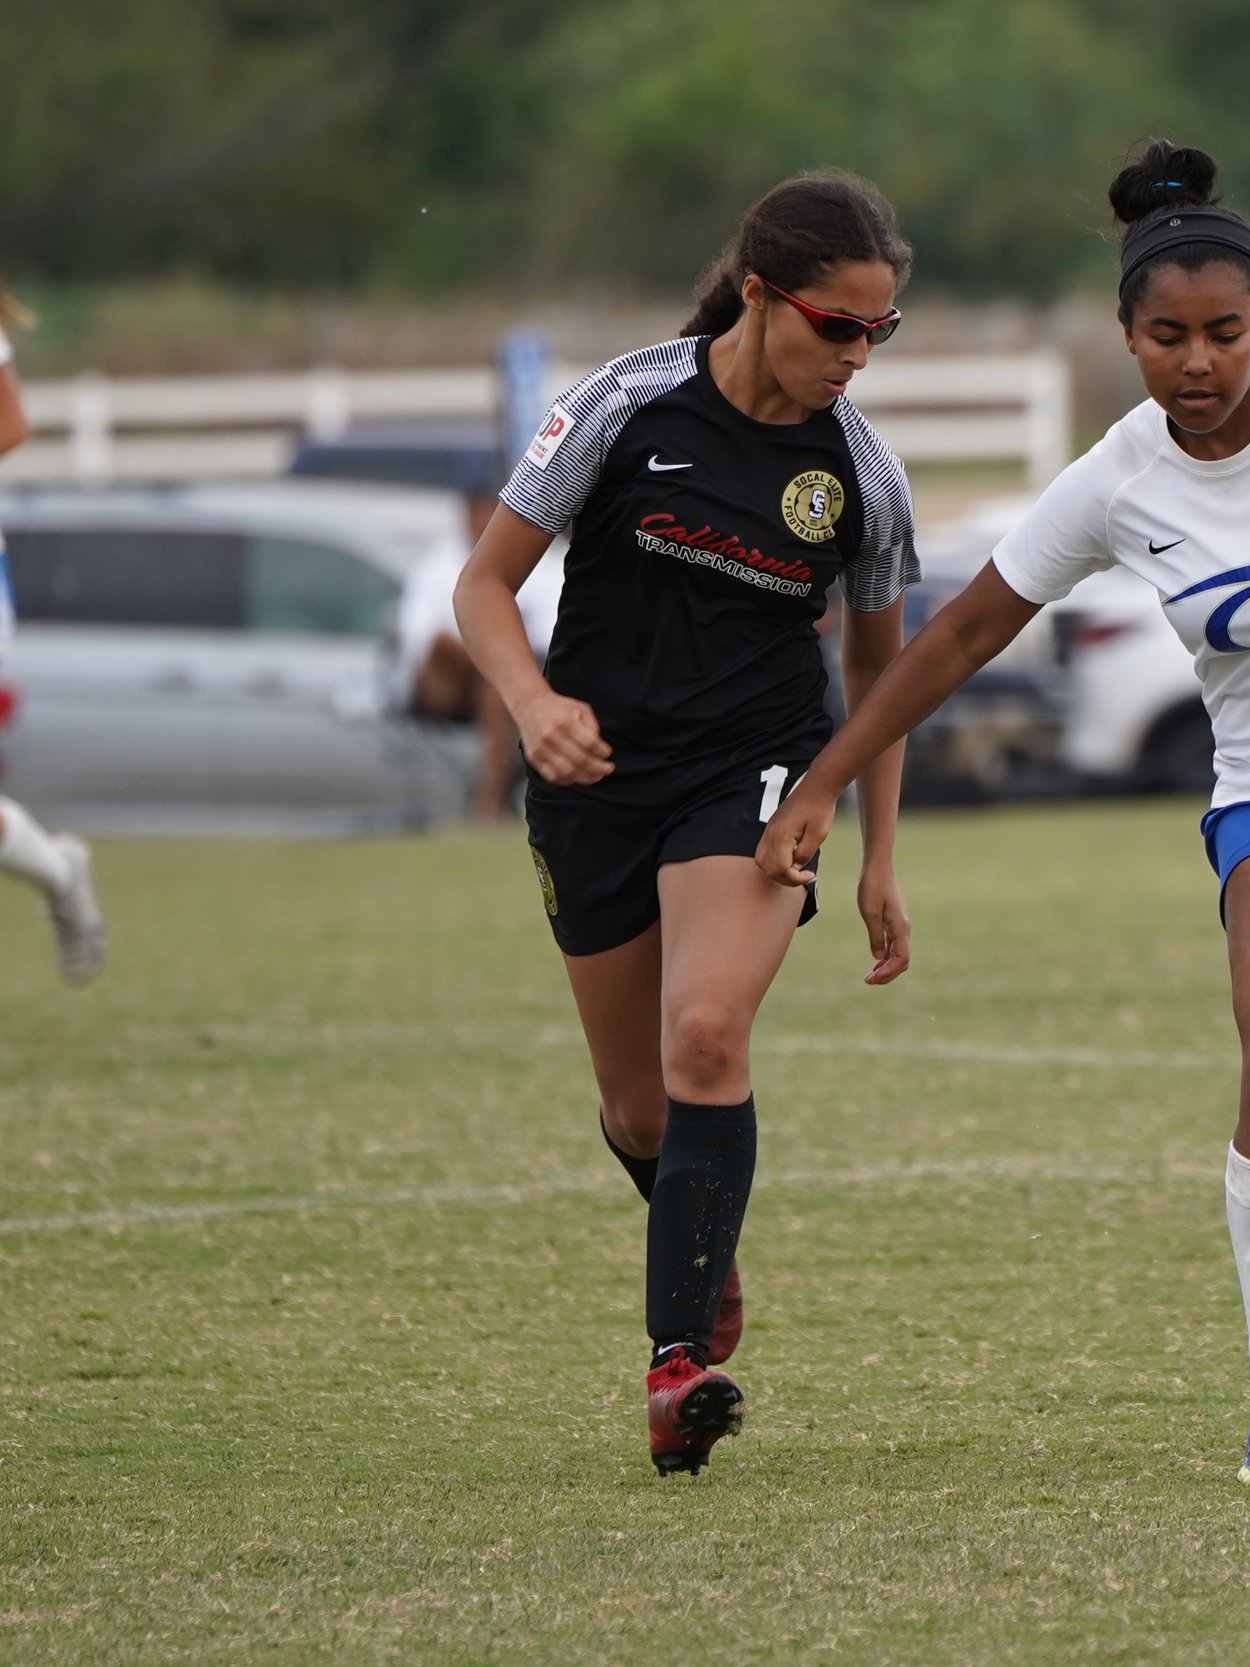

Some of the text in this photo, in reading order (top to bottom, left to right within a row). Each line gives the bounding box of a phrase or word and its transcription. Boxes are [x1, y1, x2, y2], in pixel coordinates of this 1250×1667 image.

[793, 473, 842, 503] SOCAL ELITE
[640, 513, 812, 580] California
[784, 505, 834, 541] FOOTBALL CL
[634, 529, 812, 597] TRANSMISSION
[759, 764, 808, 823] 1
